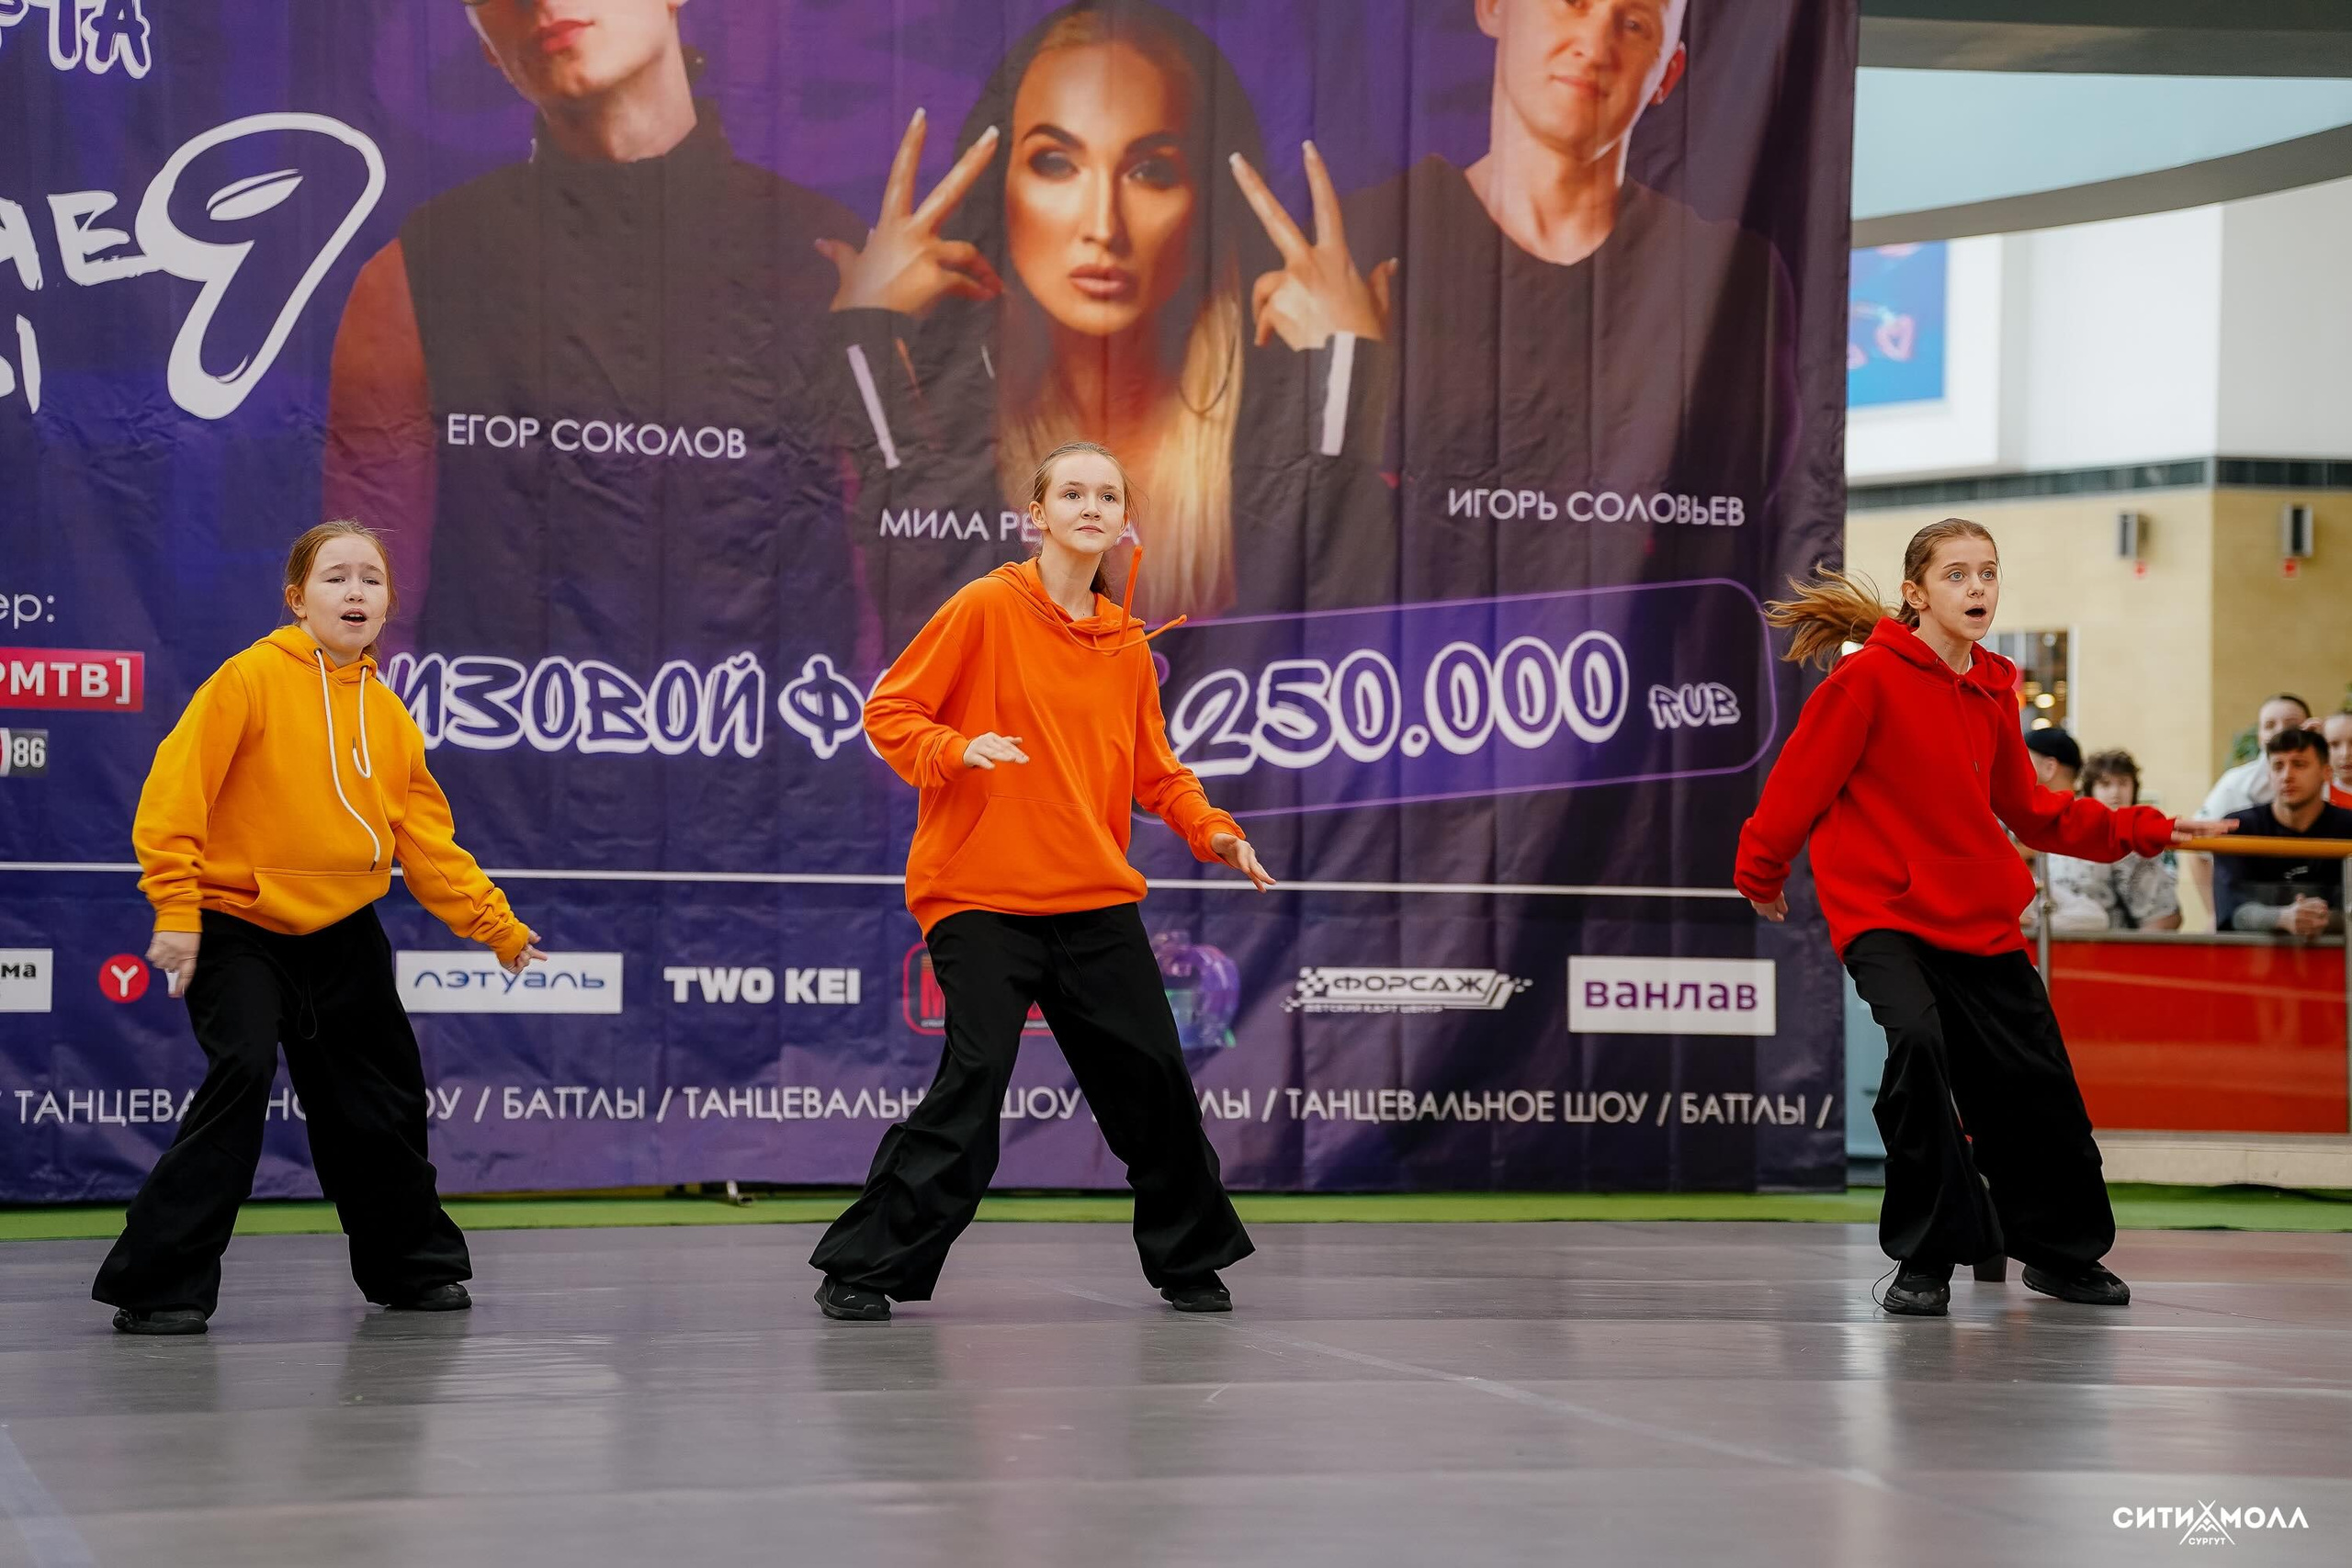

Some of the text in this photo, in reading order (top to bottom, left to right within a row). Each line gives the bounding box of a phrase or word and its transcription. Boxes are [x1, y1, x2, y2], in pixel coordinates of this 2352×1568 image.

[447, 413, 747, 459] ЕГОР СОКОЛОВ
[879, 508, 989, 541] МИЛА
[1448, 488, 1746, 526] ИГОРЬ СОЛОВЬЕВ
[377, 650, 766, 758] ИЗОВОЙ
[1170, 630, 1629, 777] 250.000
[1649, 682, 1740, 730] RUB
[13, 737, 46, 768] 86
[663, 966, 861, 1004] TWO KEI
[1333, 976, 1487, 994] ФОРСАЖ
[1585, 981, 1758, 1011] ванлав
[1285, 1088, 1555, 1124] ТАНЦЕВАЛЬНОЕ
[1564, 1090, 1649, 1123] ШОУ
